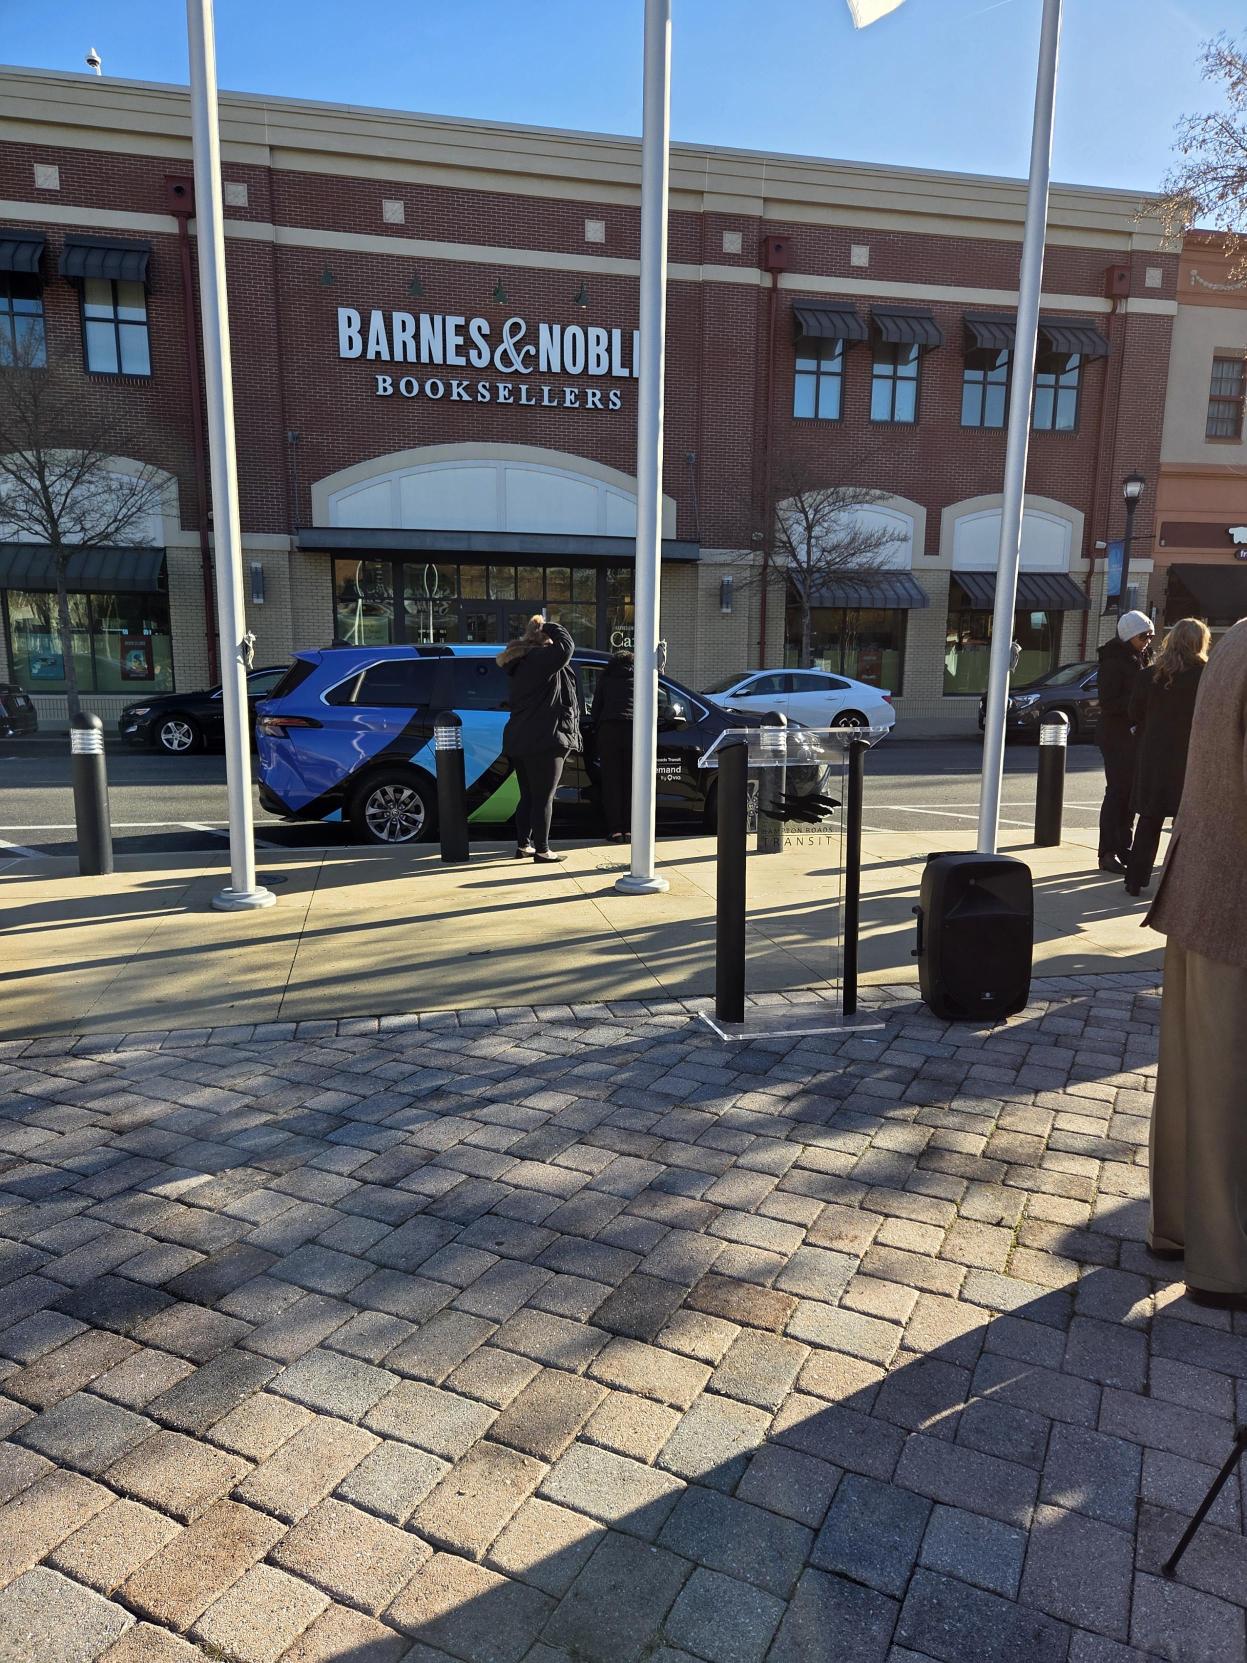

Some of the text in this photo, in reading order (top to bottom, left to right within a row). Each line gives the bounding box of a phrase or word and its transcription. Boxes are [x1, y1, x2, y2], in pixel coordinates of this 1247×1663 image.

[337, 307, 491, 368] BARNES
[375, 374, 622, 410] BOOKSELLERS
[610, 631, 634, 648] Ca
[655, 765, 682, 774] emand
[764, 835, 832, 847] TRANSIT
